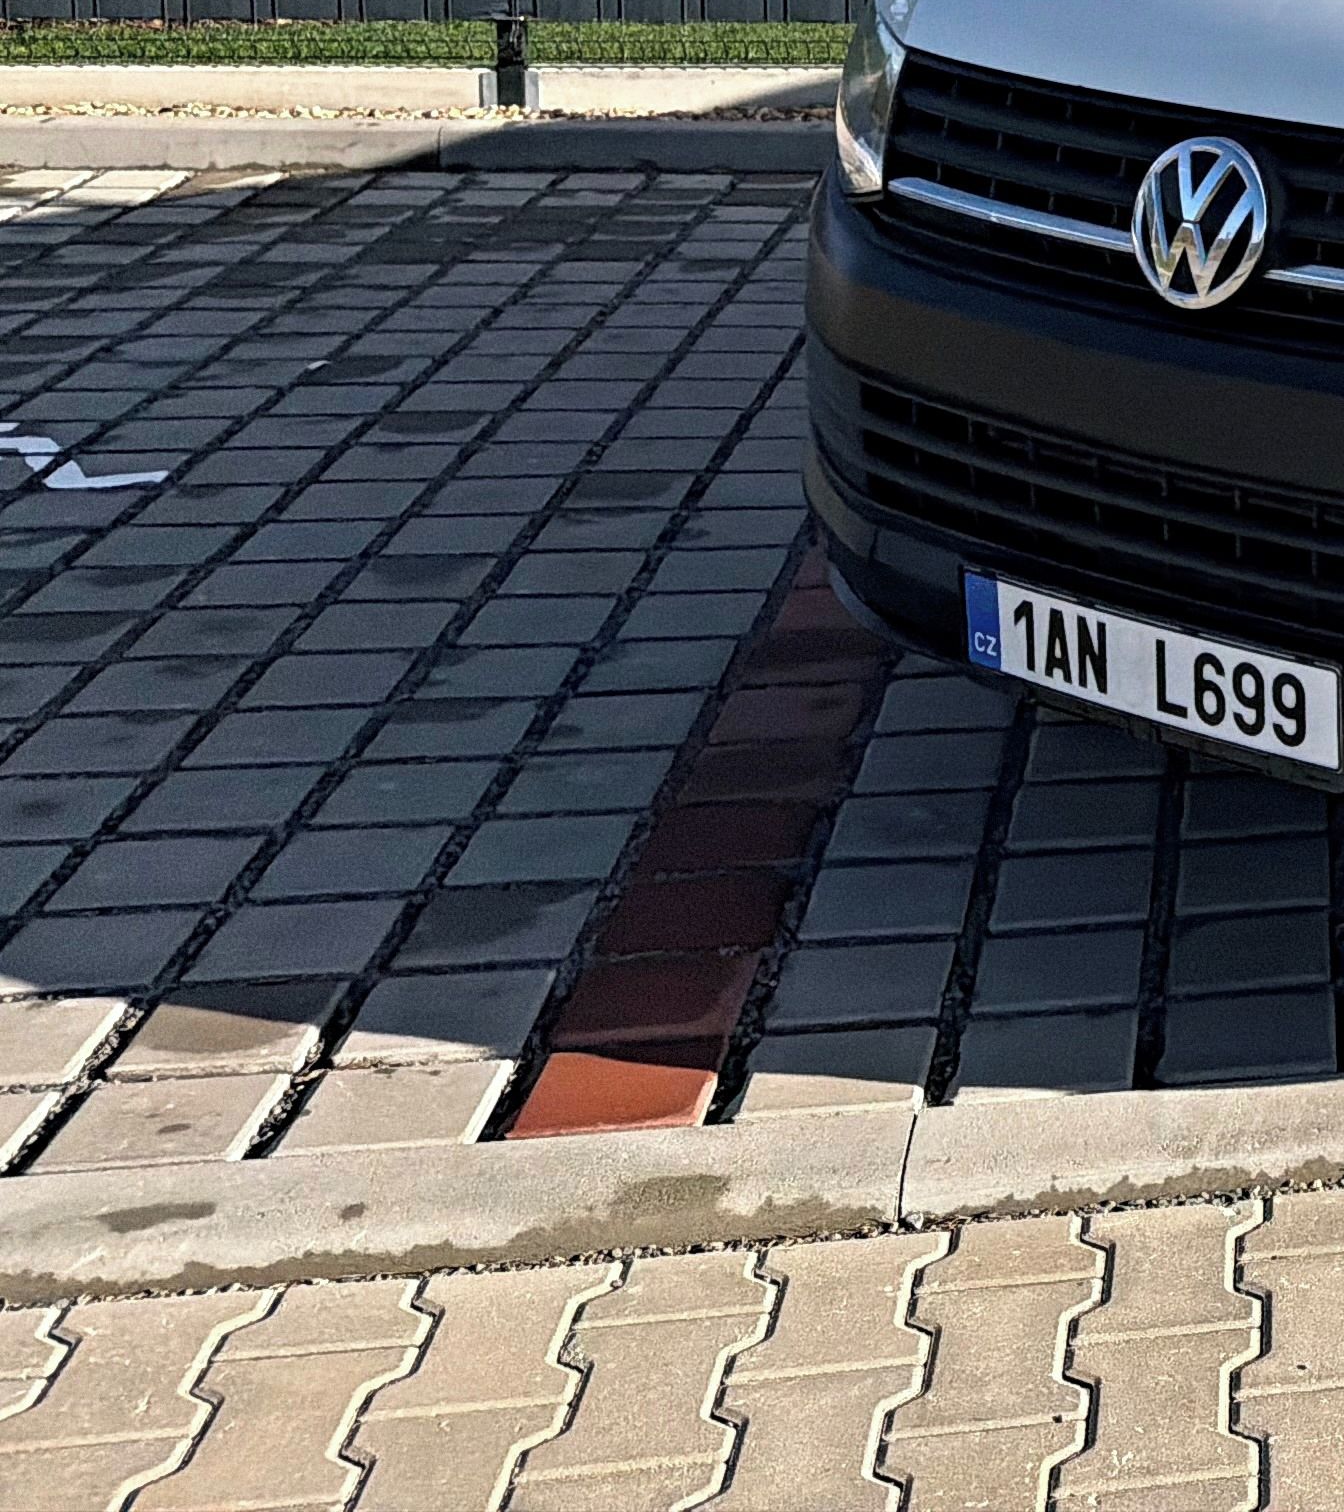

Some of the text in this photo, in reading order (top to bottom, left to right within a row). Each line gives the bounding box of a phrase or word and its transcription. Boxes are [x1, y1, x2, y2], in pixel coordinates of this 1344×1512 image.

[1131, 136, 1267, 310] VW
[974, 631, 997, 657] CZ
[1014, 599, 1307, 748] 1AN L699
